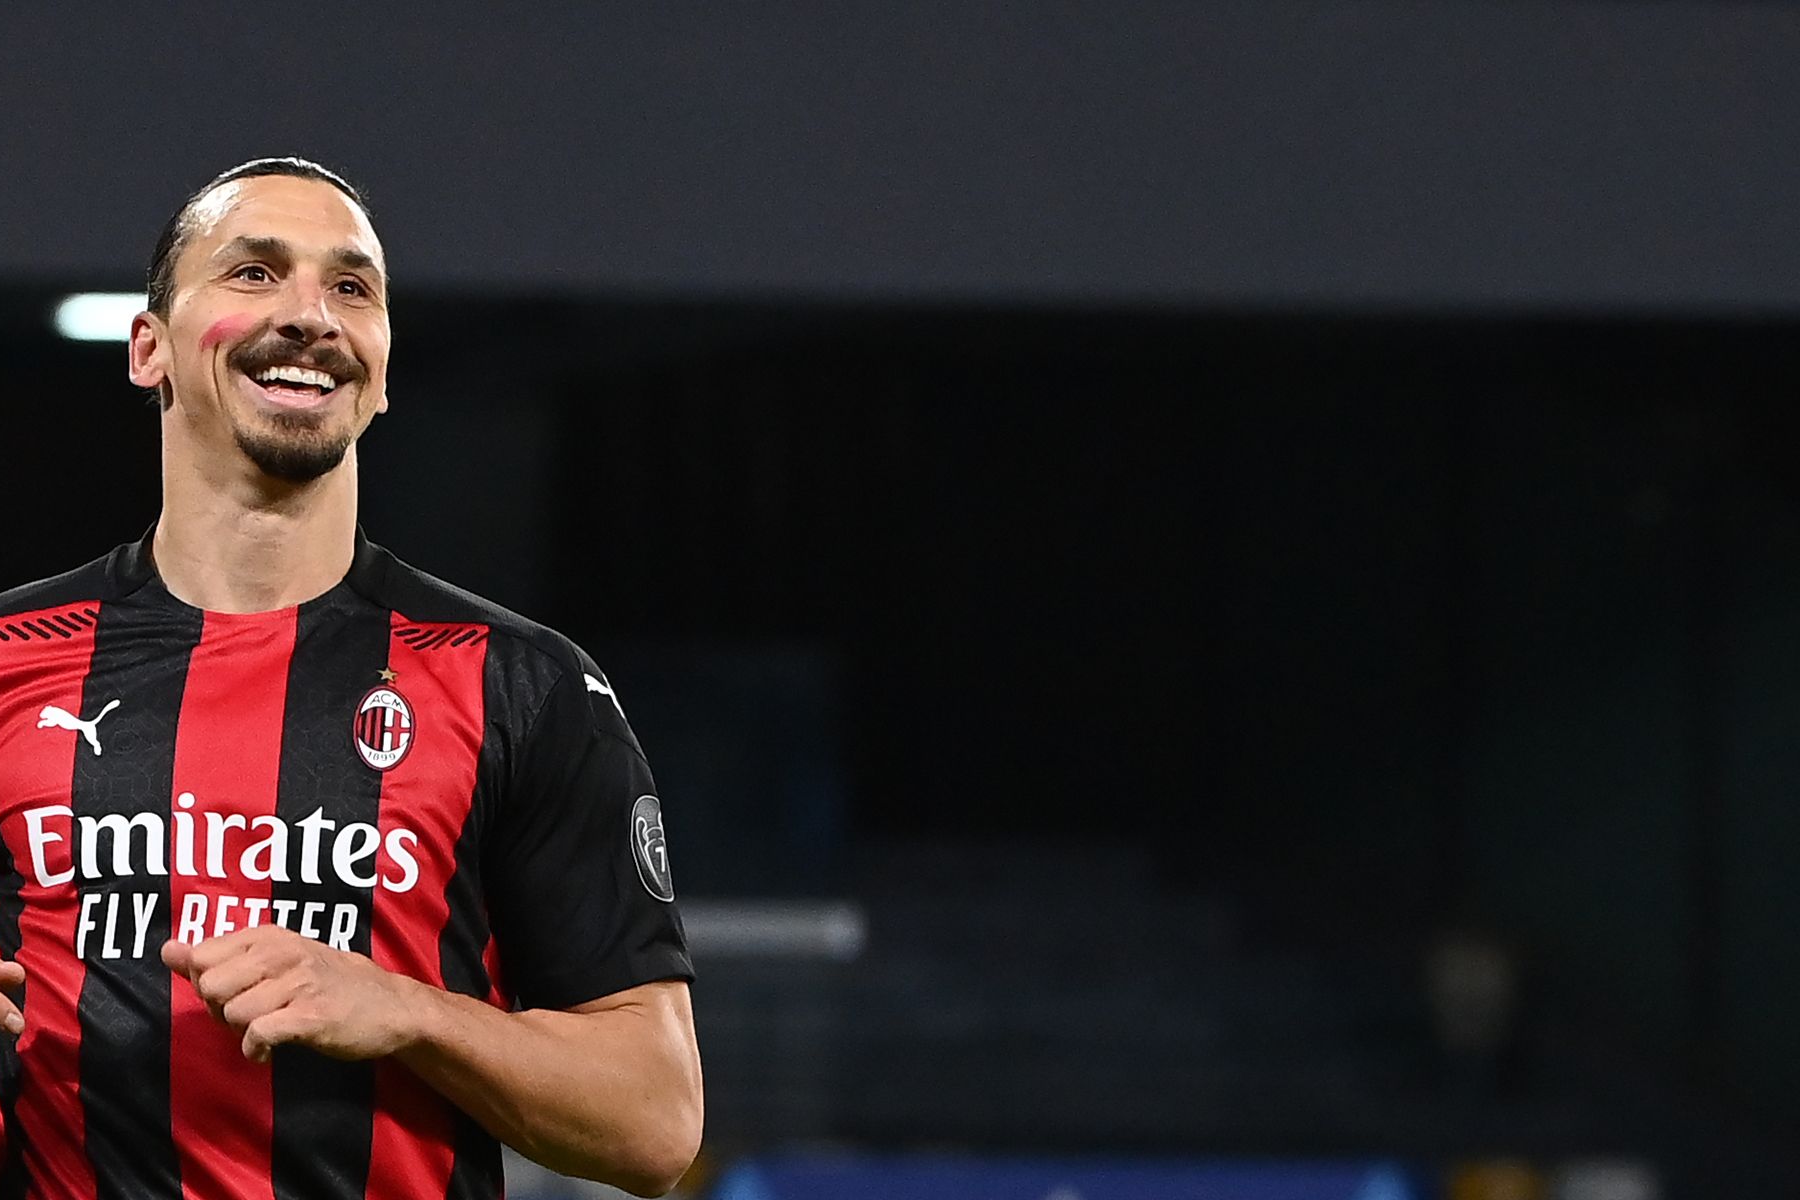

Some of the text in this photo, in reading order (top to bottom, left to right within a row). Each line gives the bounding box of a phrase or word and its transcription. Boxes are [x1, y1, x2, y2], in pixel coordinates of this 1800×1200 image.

[369, 694, 403, 710] ACM
[367, 751, 397, 762] 1899
[22, 792, 419, 893] Emirates
[76, 893, 159, 960] FLY
